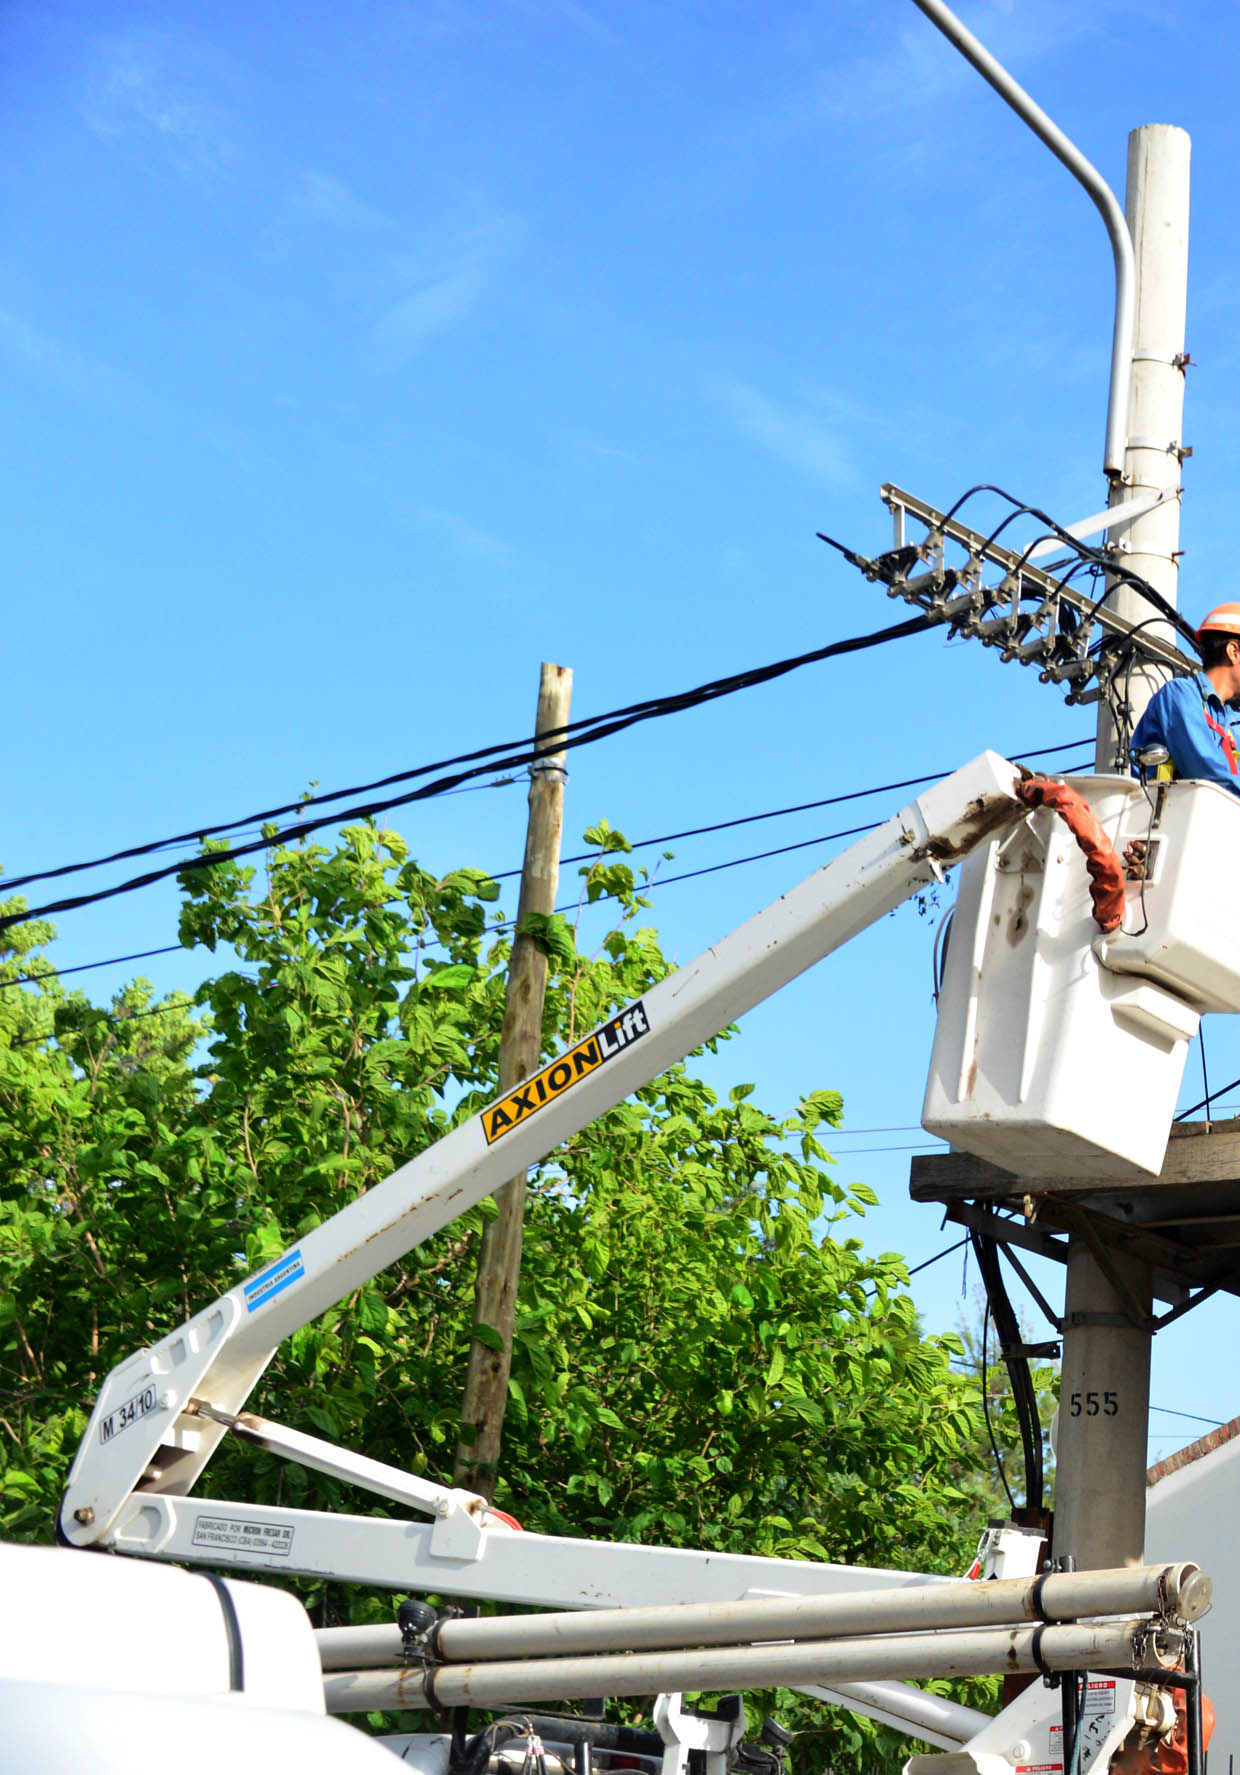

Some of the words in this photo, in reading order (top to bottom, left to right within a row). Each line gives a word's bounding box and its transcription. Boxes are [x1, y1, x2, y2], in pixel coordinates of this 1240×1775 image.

[489, 1043, 600, 1137] AXION
[598, 1007, 648, 1059] Lift
[274, 1261, 301, 1283] ARGENTINA
[103, 1416, 114, 1440] M
[119, 1390, 152, 1428] 34/10
[1070, 1391, 1119, 1417] 555
[196, 1531, 206, 1540] SAN
[207, 1532, 237, 1544] FRANCISCO
[198, 1520, 229, 1532] FABRICADO
[230, 1525, 241, 1533] POR
